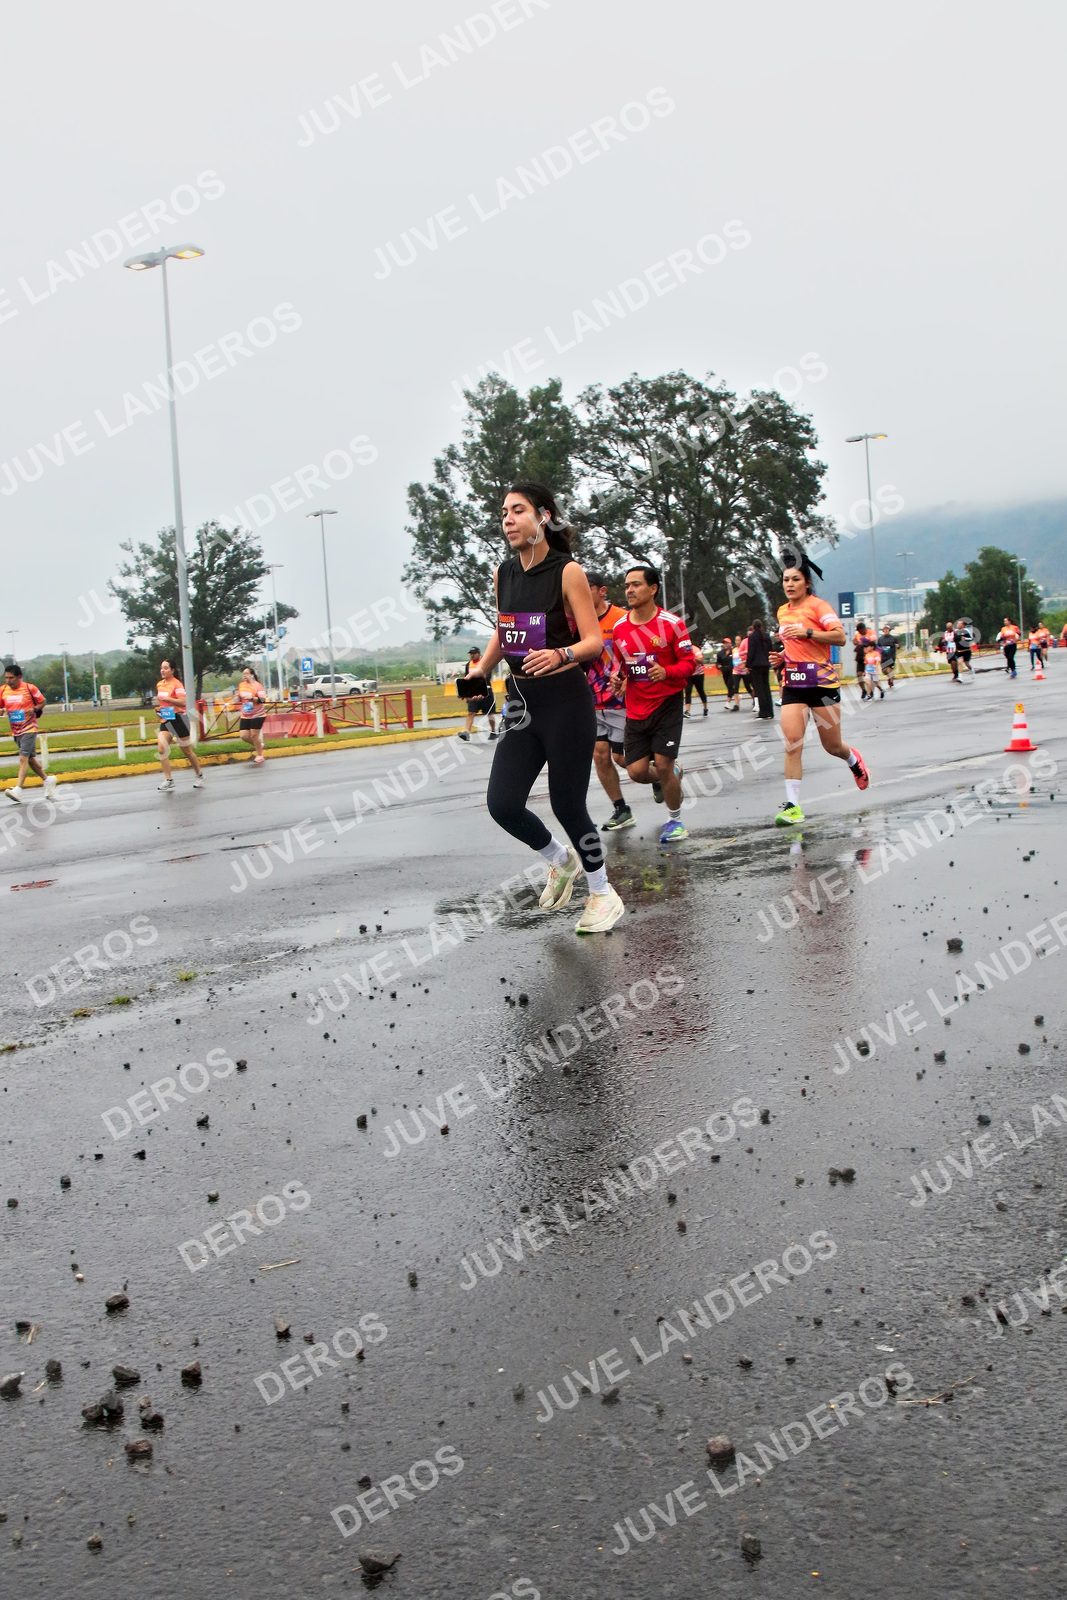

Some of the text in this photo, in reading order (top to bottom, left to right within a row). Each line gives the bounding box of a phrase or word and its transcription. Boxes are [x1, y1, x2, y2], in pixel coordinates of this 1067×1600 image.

[841, 603, 851, 615] E
[505, 630, 527, 644] 677
[631, 665, 647, 674] 198
[790, 672, 807, 681] 680
